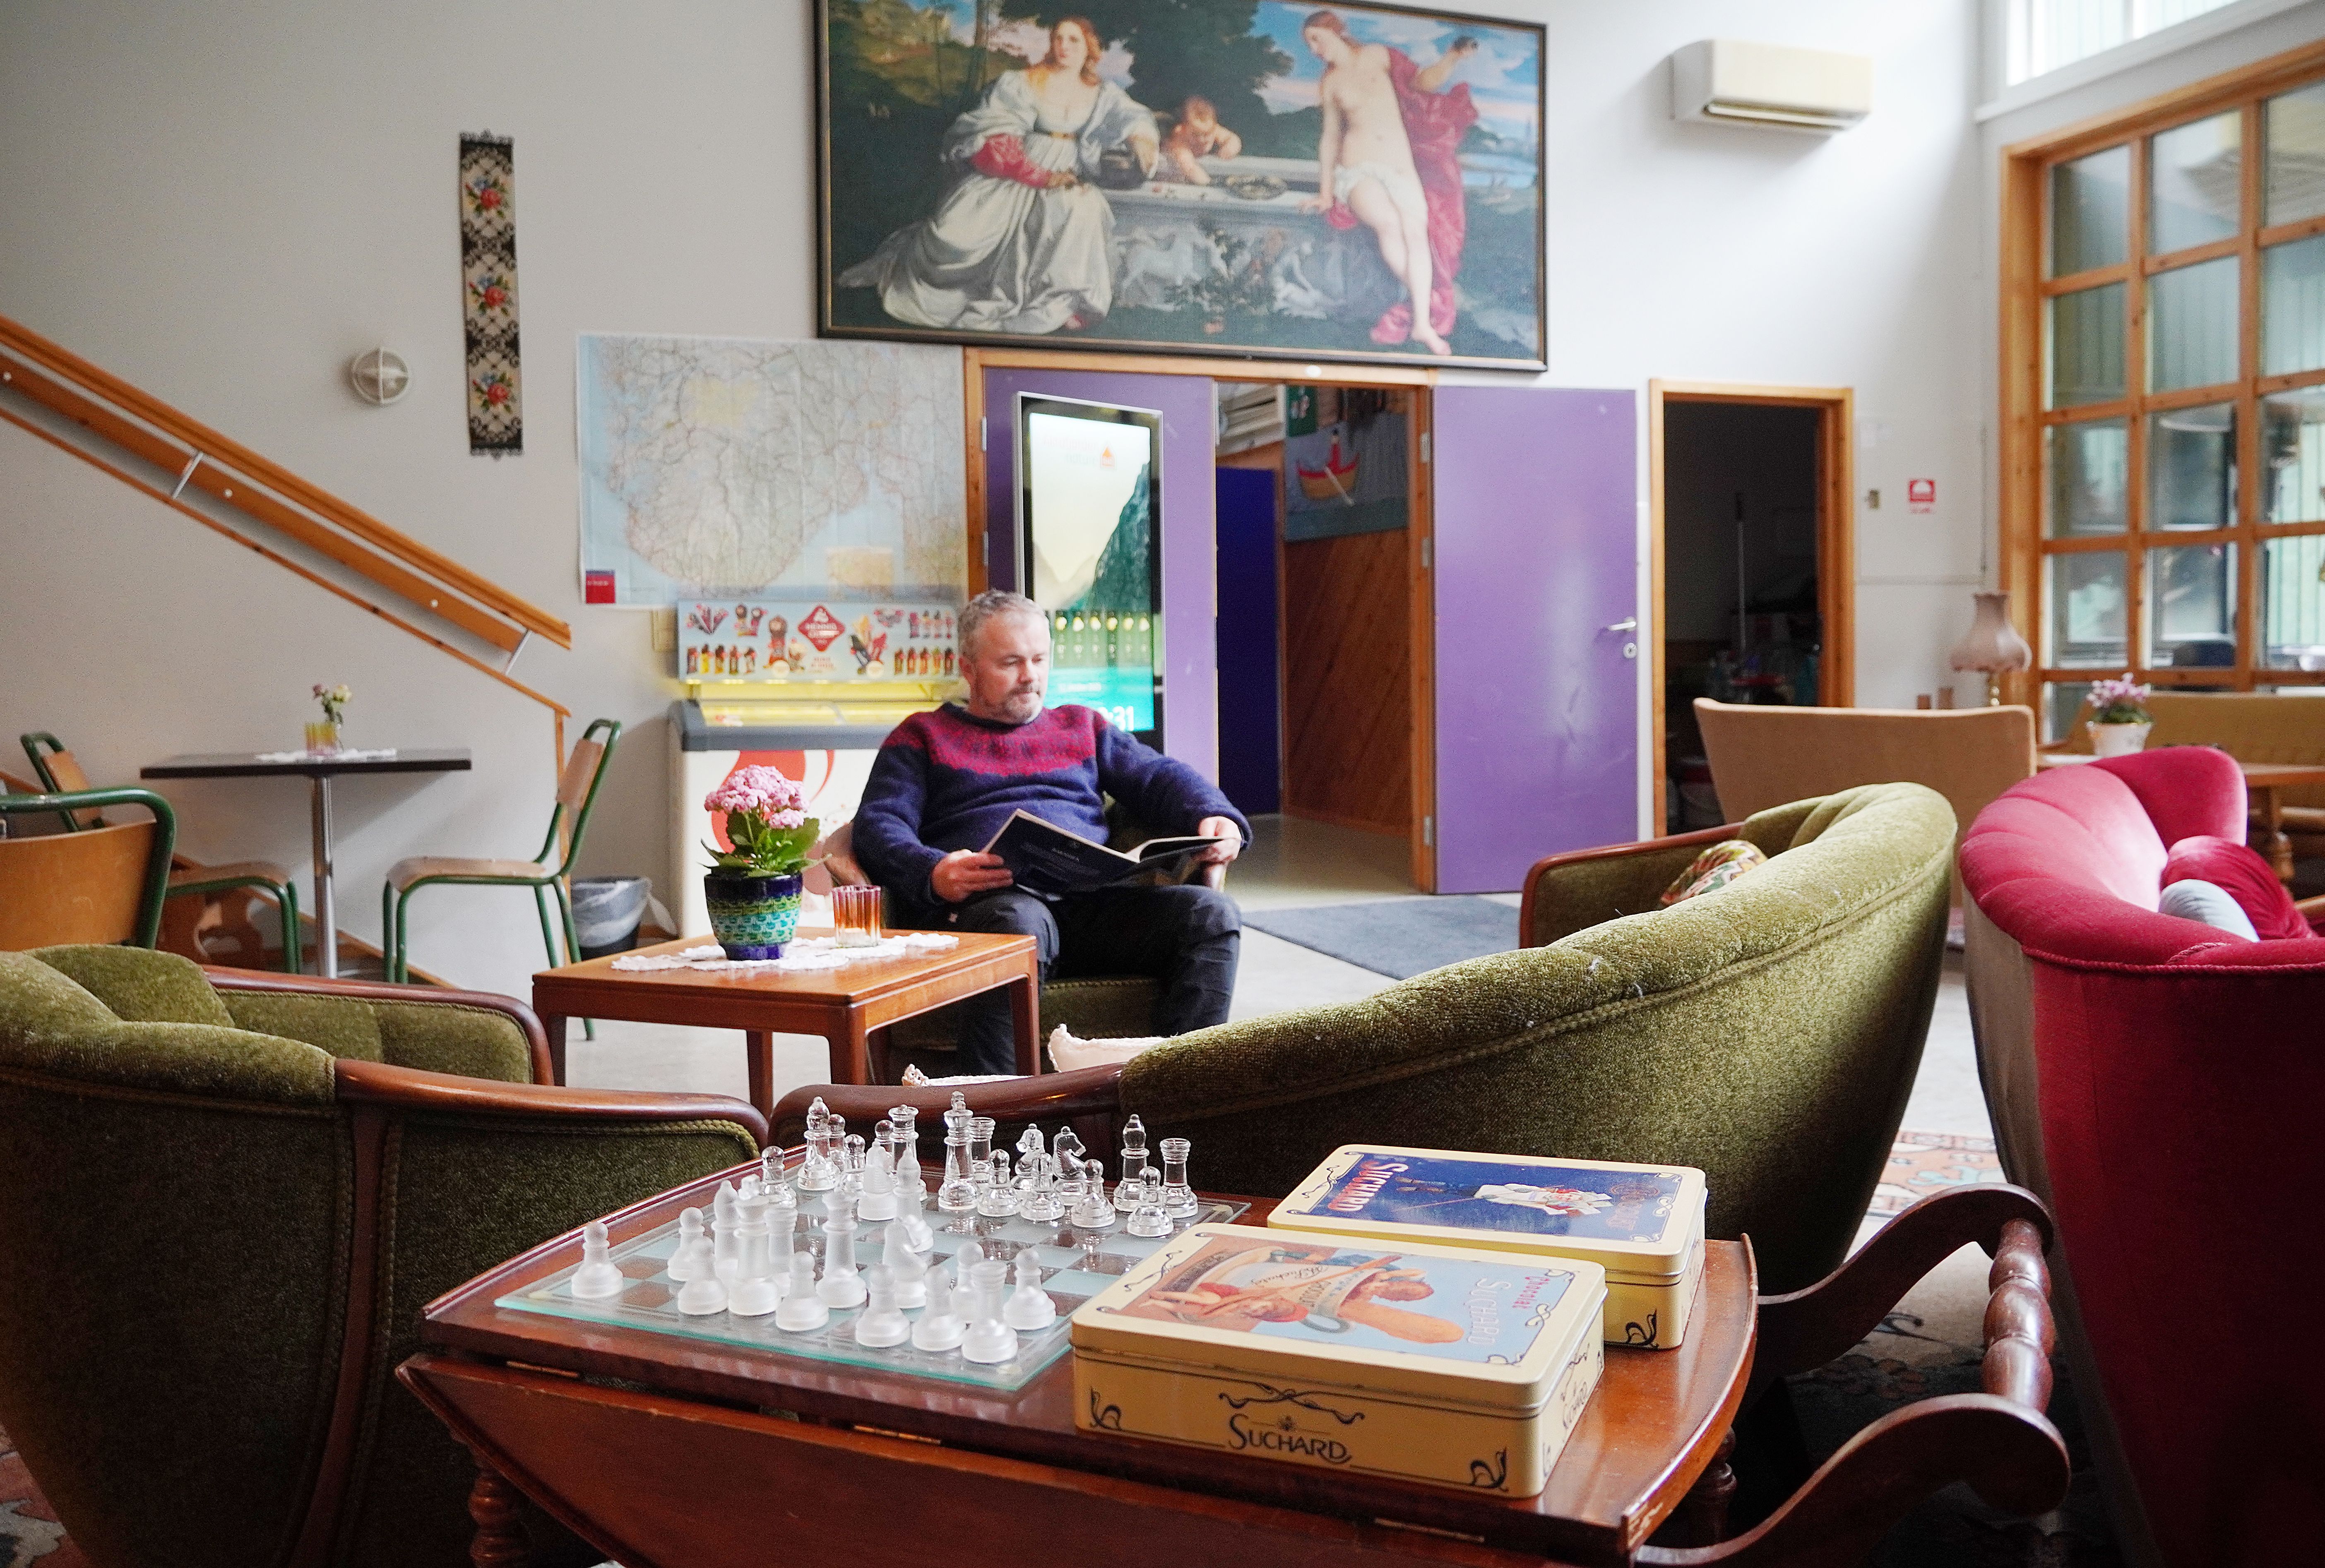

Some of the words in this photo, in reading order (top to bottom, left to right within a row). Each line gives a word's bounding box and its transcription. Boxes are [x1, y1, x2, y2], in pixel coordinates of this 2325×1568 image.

[1327, 1160, 1409, 1212] SUCHARD
[1467, 1277, 1512, 1345] SUCHARD
[1512, 1275, 1550, 1309] Chocolat
[1228, 1413, 1352, 1464] SUCHARD
